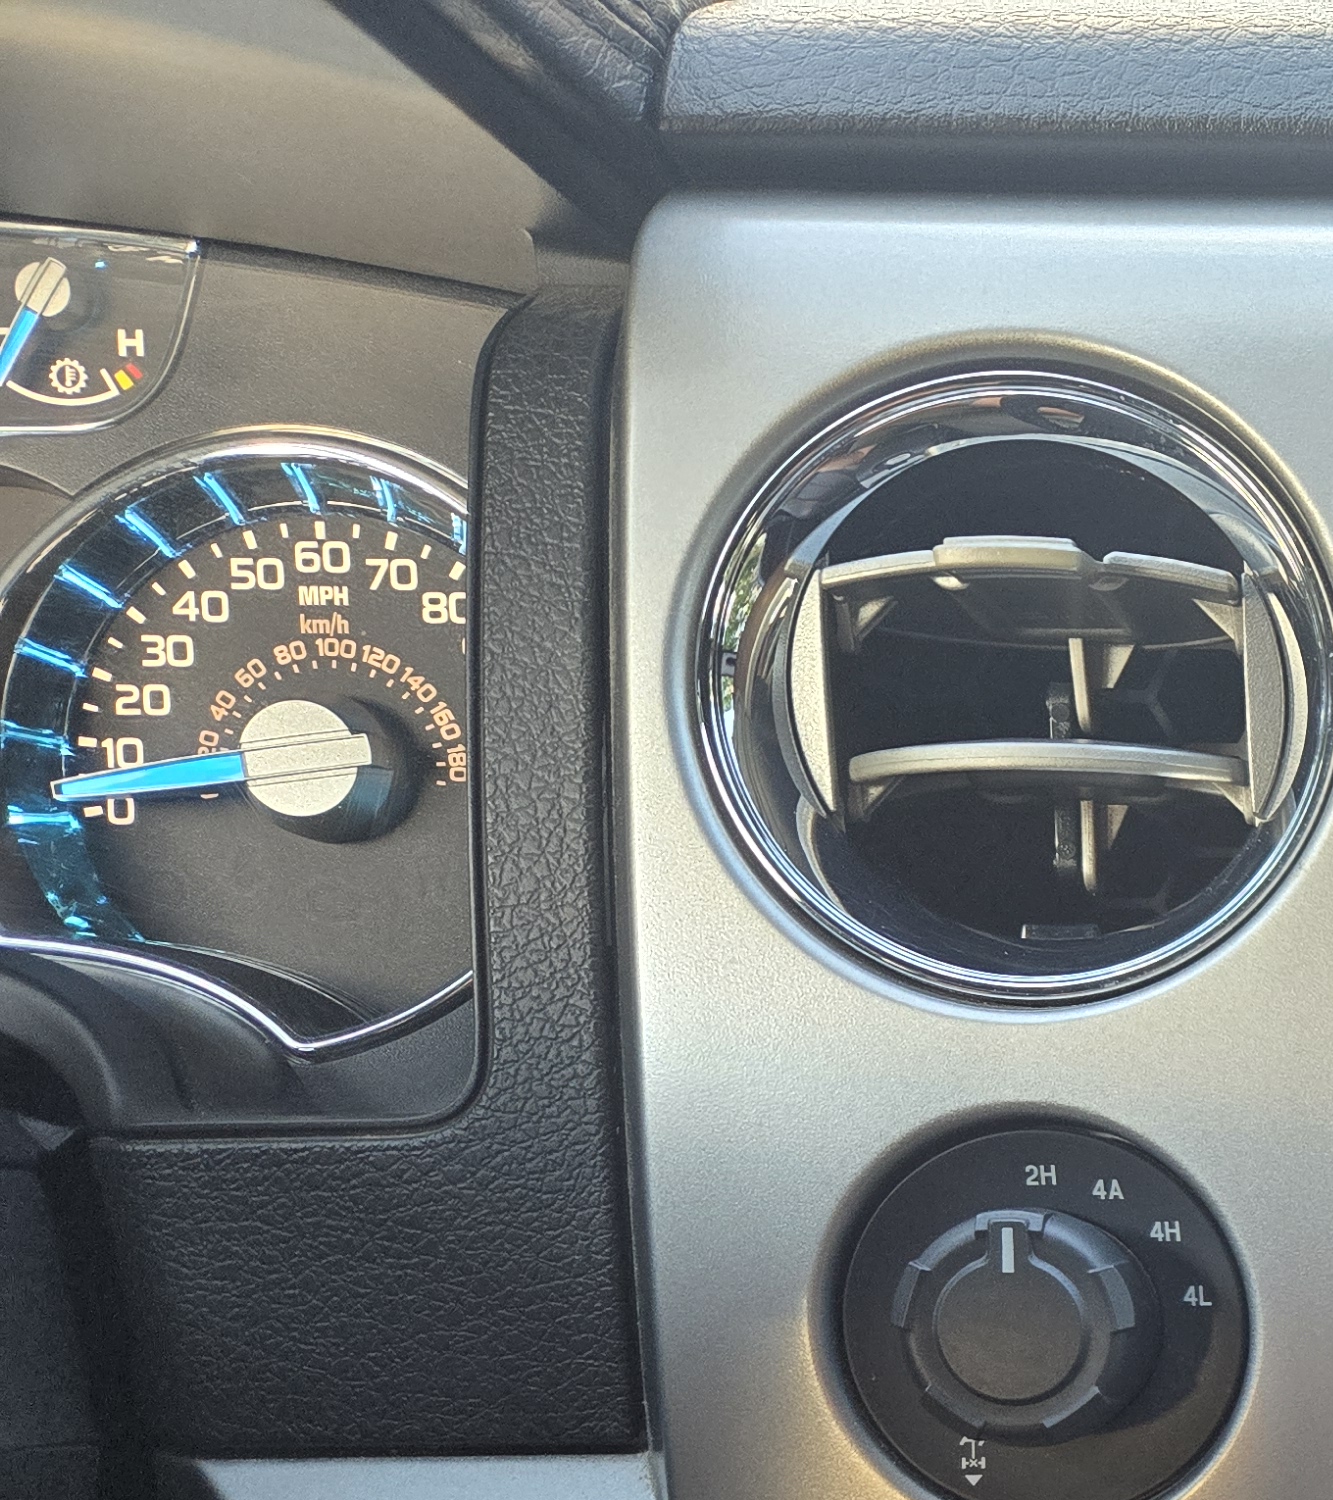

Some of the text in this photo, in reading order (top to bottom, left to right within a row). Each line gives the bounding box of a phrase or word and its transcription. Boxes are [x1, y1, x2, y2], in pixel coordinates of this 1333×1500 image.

[117, 329, 145, 357] H
[294, 541, 350, 574] 60
[230, 558, 284, 592] 50
[365, 558, 418, 592] 70
[172, 591, 229, 623] 40
[298, 586, 349, 606] MPH
[299, 613, 350, 636] km/h
[141, 633, 194, 667] 30
[273, 640, 307, 666] 80
[315, 637, 357, 659] 100
[362, 644, 401, 675] 120
[234, 658, 267, 689] 60
[400, 666, 438, 703] 140
[114, 685, 171, 716] 20
[210, 690, 236, 721] 40
[429, 701, 462, 741] 160
[102, 737, 144, 770] 10
[447, 744, 467, 782] 180
[1024, 1164, 1057, 1187] 2H
[1092, 1179, 1125, 1201] 4A
[1150, 1221, 1182, 1243] 4H
[1183, 1285, 1213, 1307] 4L
